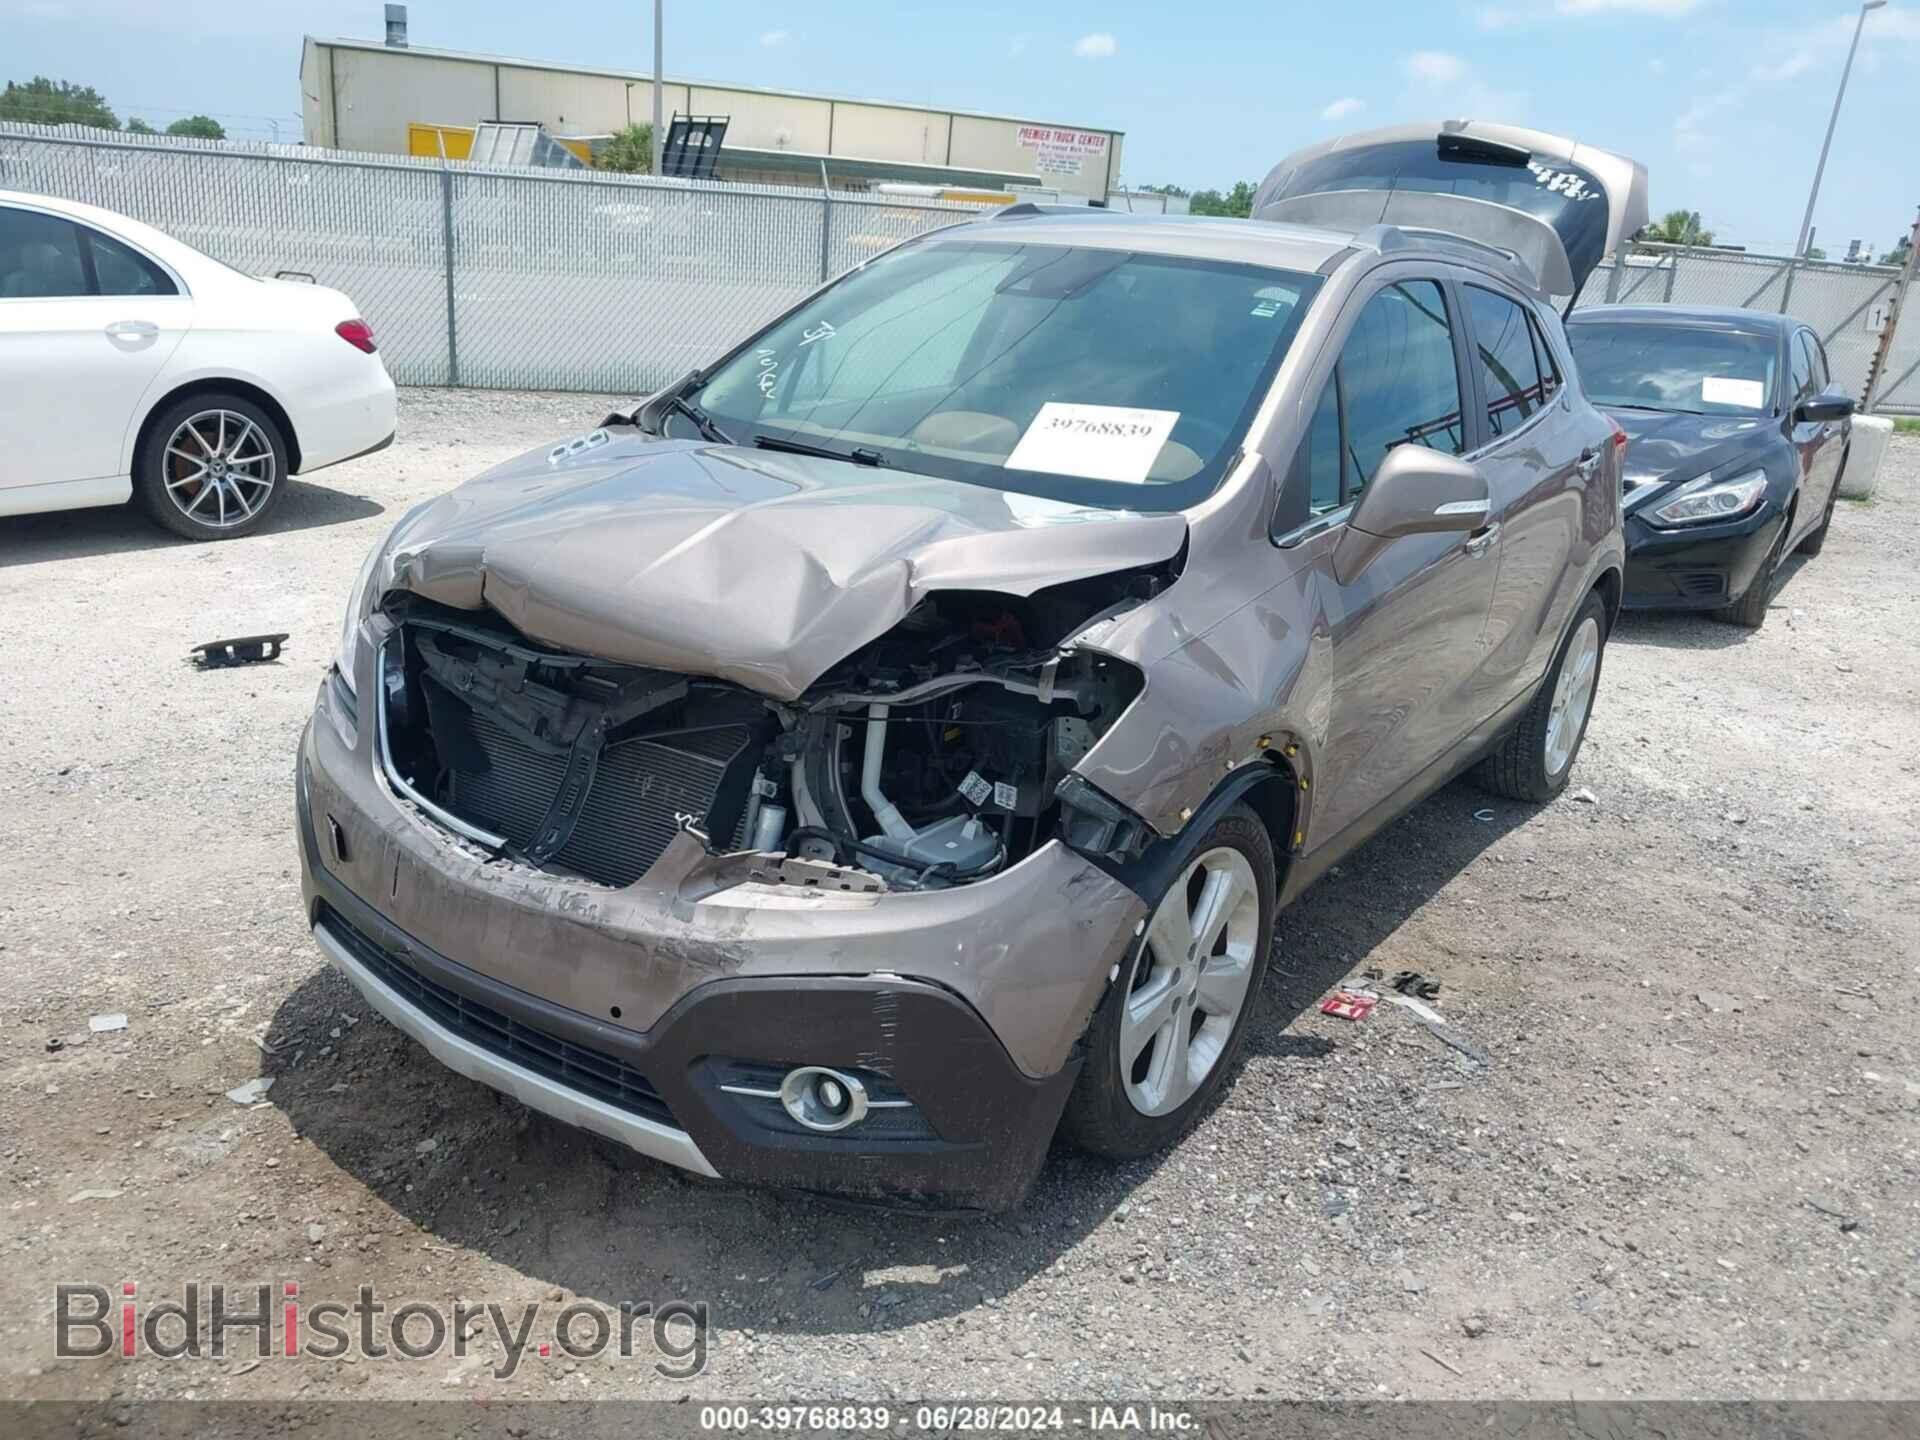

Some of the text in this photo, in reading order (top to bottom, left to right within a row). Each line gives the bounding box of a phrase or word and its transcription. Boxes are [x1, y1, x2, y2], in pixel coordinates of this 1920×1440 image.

[1019, 127, 1051, 141] PREMIER
[1054, 131, 1076, 144] TRUCK
[1079, 134, 1105, 147] CENTER
[1046, 416, 1153, 438] 39768839
